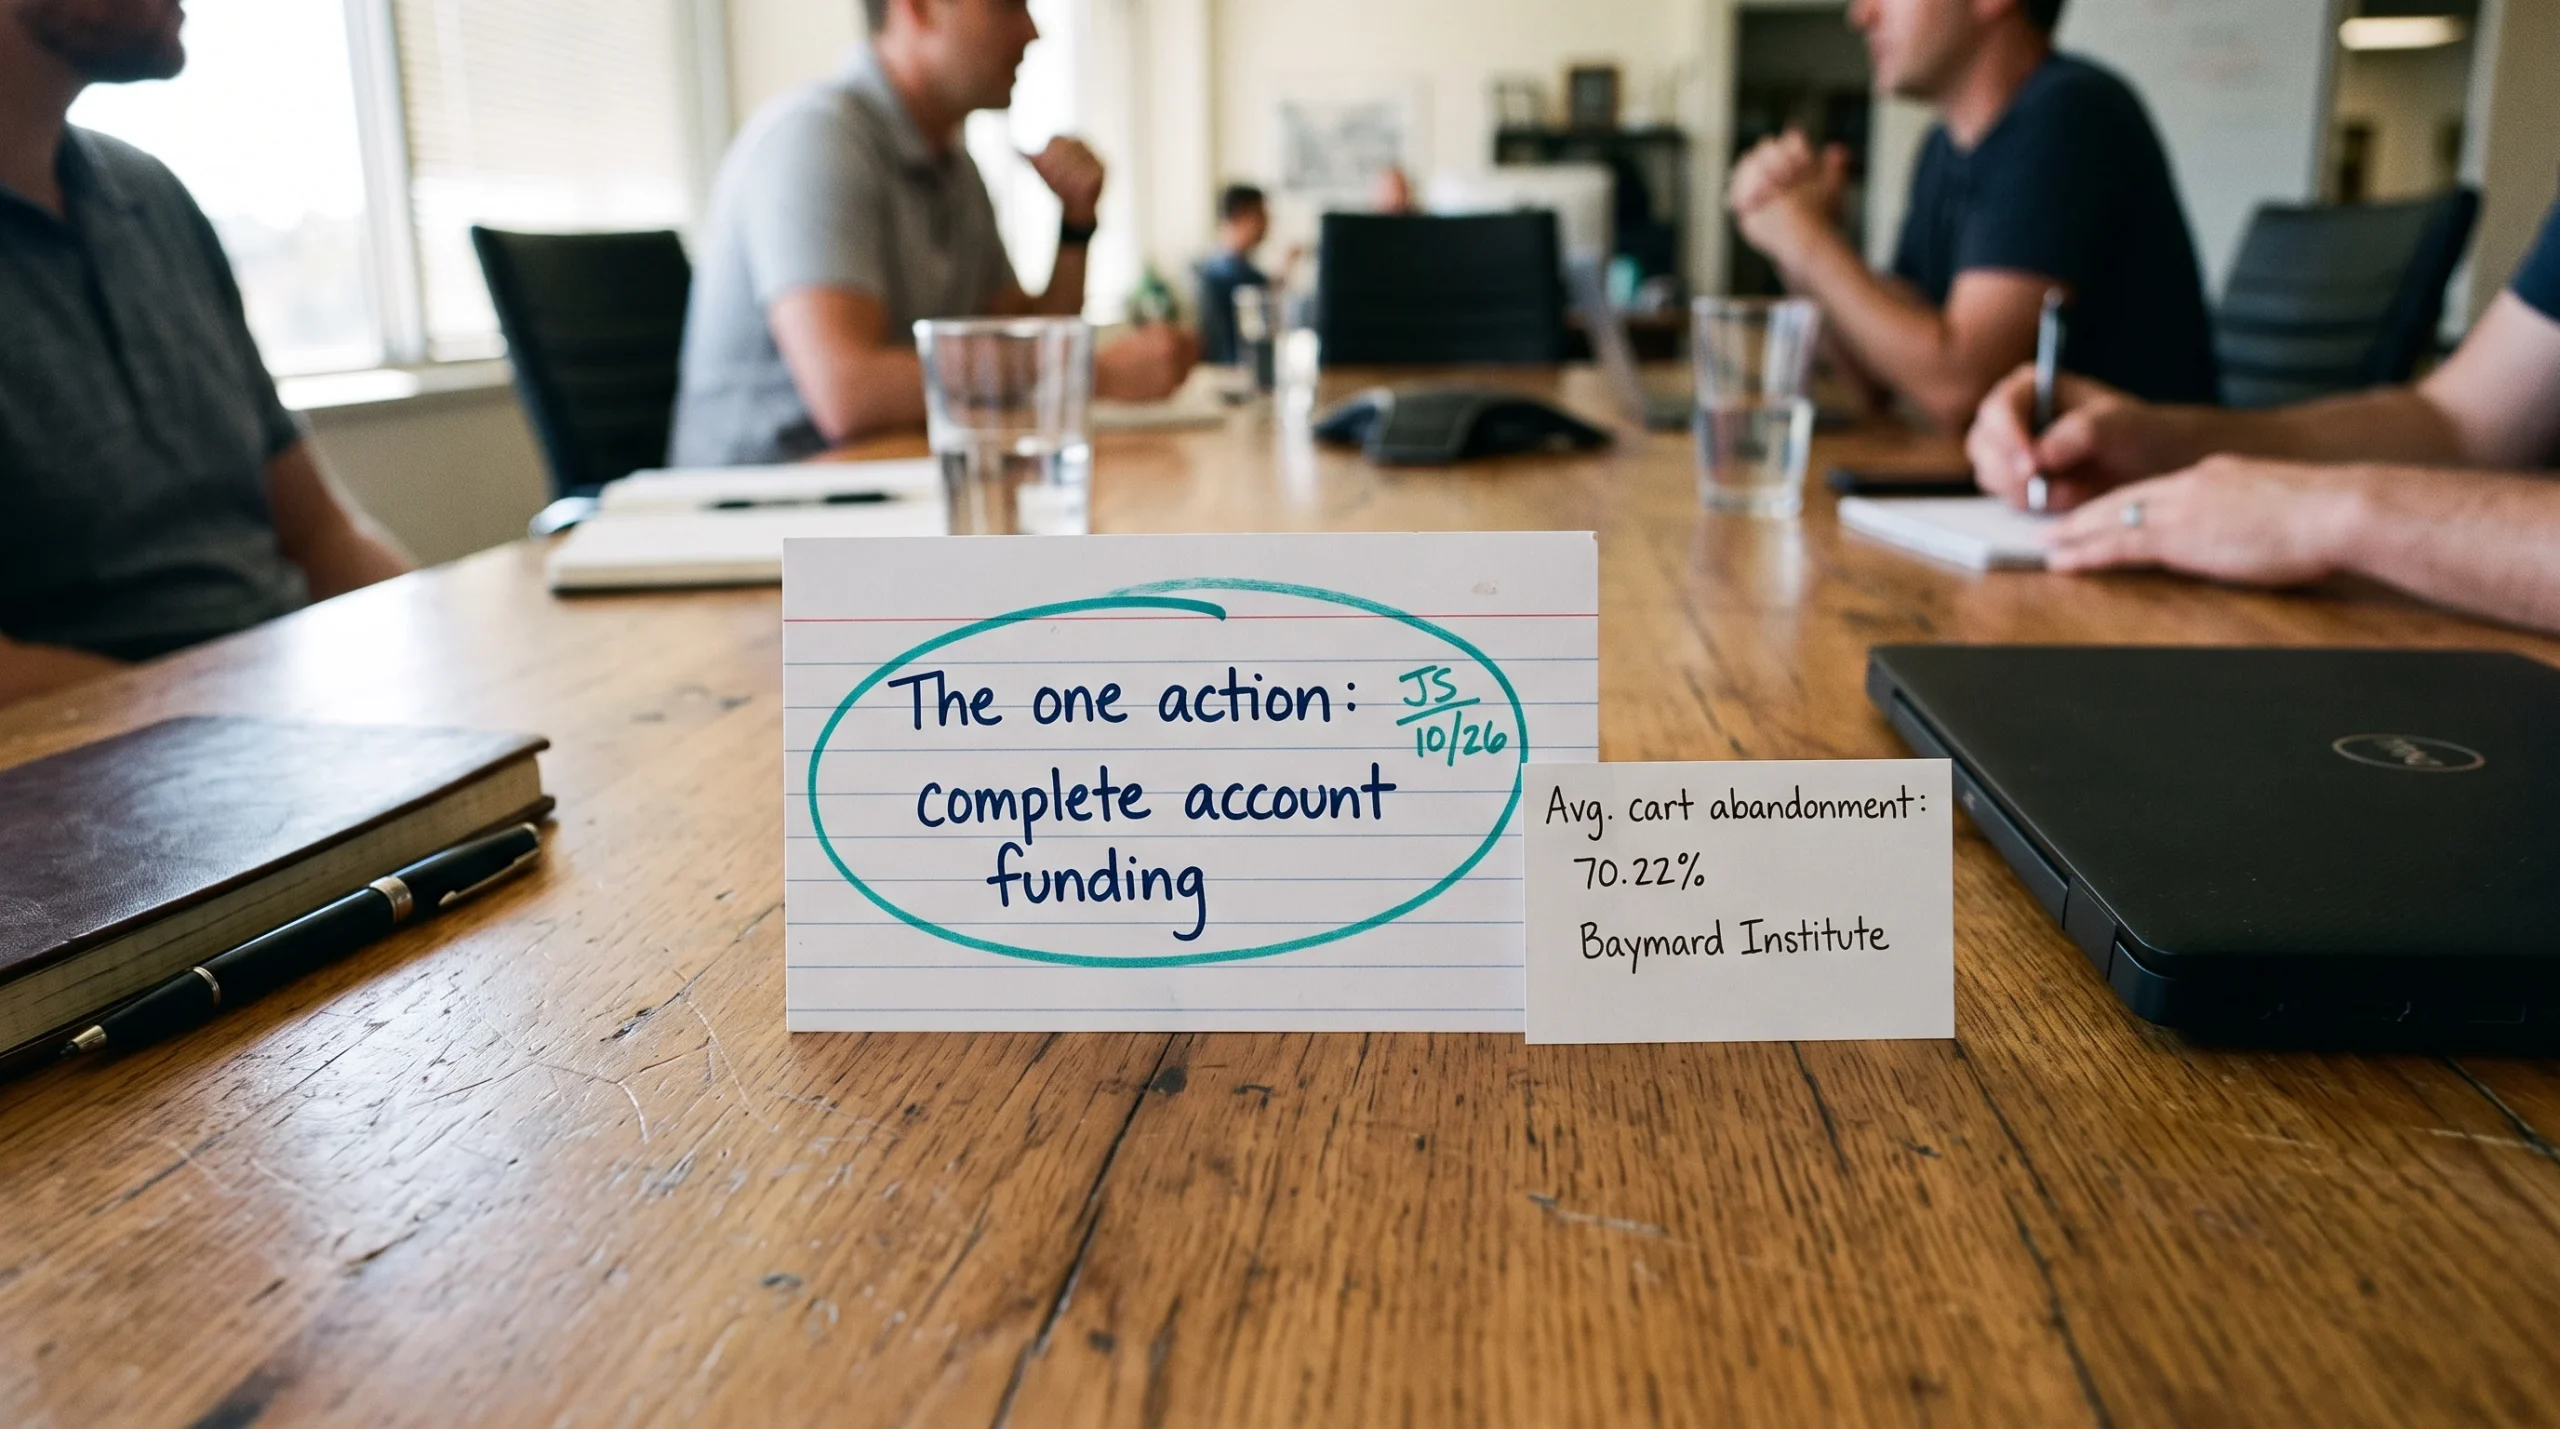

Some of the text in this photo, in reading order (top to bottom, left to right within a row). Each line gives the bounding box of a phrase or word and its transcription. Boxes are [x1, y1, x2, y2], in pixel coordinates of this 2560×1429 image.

[888, 666, 1356, 732] The one action:
[1398, 664, 1457, 707] JS
[1416, 710, 1508, 767] 10/26
[917, 761, 1397, 845] complete account
[1545, 784, 1926, 842] Avg. cart abandonment:
[986, 842, 1207, 941] funding
[1573, 851, 1705, 891] 70.22%
[1579, 915, 1890, 975] Baymard Institute
